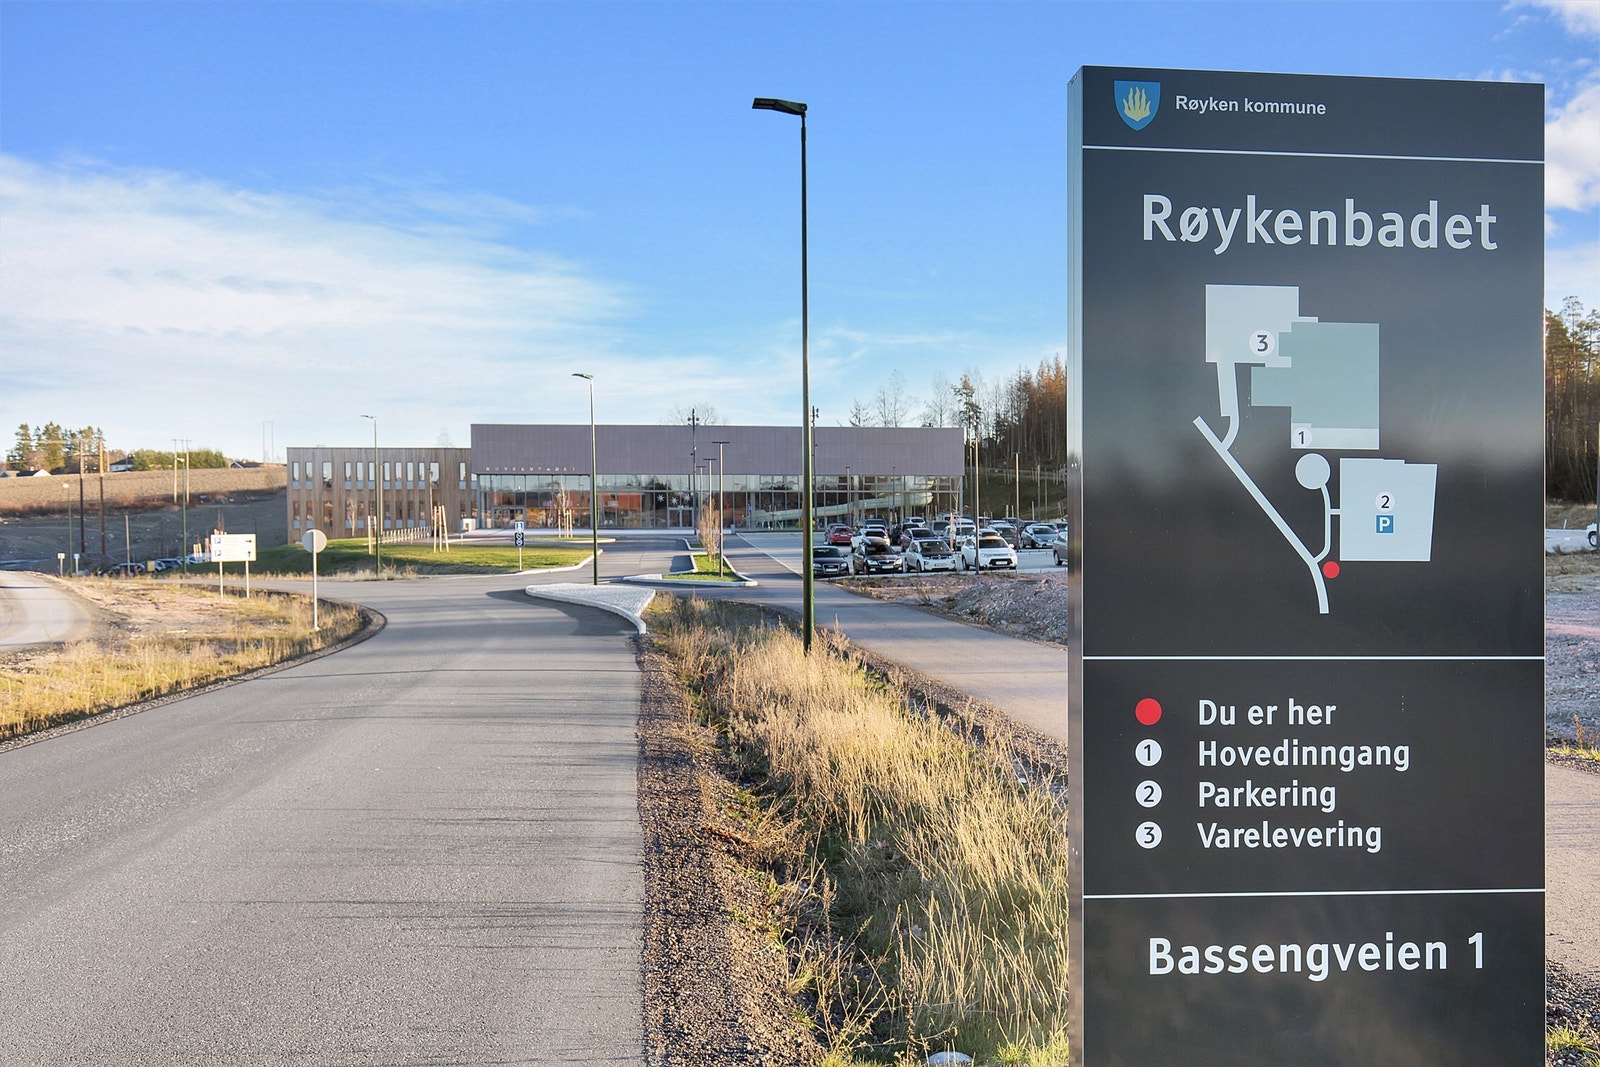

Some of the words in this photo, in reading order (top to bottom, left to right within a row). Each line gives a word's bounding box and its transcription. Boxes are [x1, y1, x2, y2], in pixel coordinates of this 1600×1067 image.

[1176, 95, 1238, 116] Røyken
[1244, 98, 1327, 115] kommune
[1143, 194, 1498, 256] Røykenbadet
[1257, 334, 1268, 352] 3
[1298, 431, 1305, 444] 1
[1381, 495, 1390, 509] 2
[1379, 517, 1391, 532] P
[1198, 699, 1236, 726] Du
[1247, 705, 1279, 726] er
[1288, 697, 1337, 725] her
[1143, 745, 1152, 762] 1
[1198, 738, 1410, 773] Hovedinngang
[1143, 785, 1154, 803] 2
[1198, 779, 1336, 814] Parkering
[1144, 827, 1155, 844] 3
[1196, 819, 1382, 854] Varelevering
[1149, 931, 1447, 982] Bassengveien
[1468, 932, 1483, 969] 1
